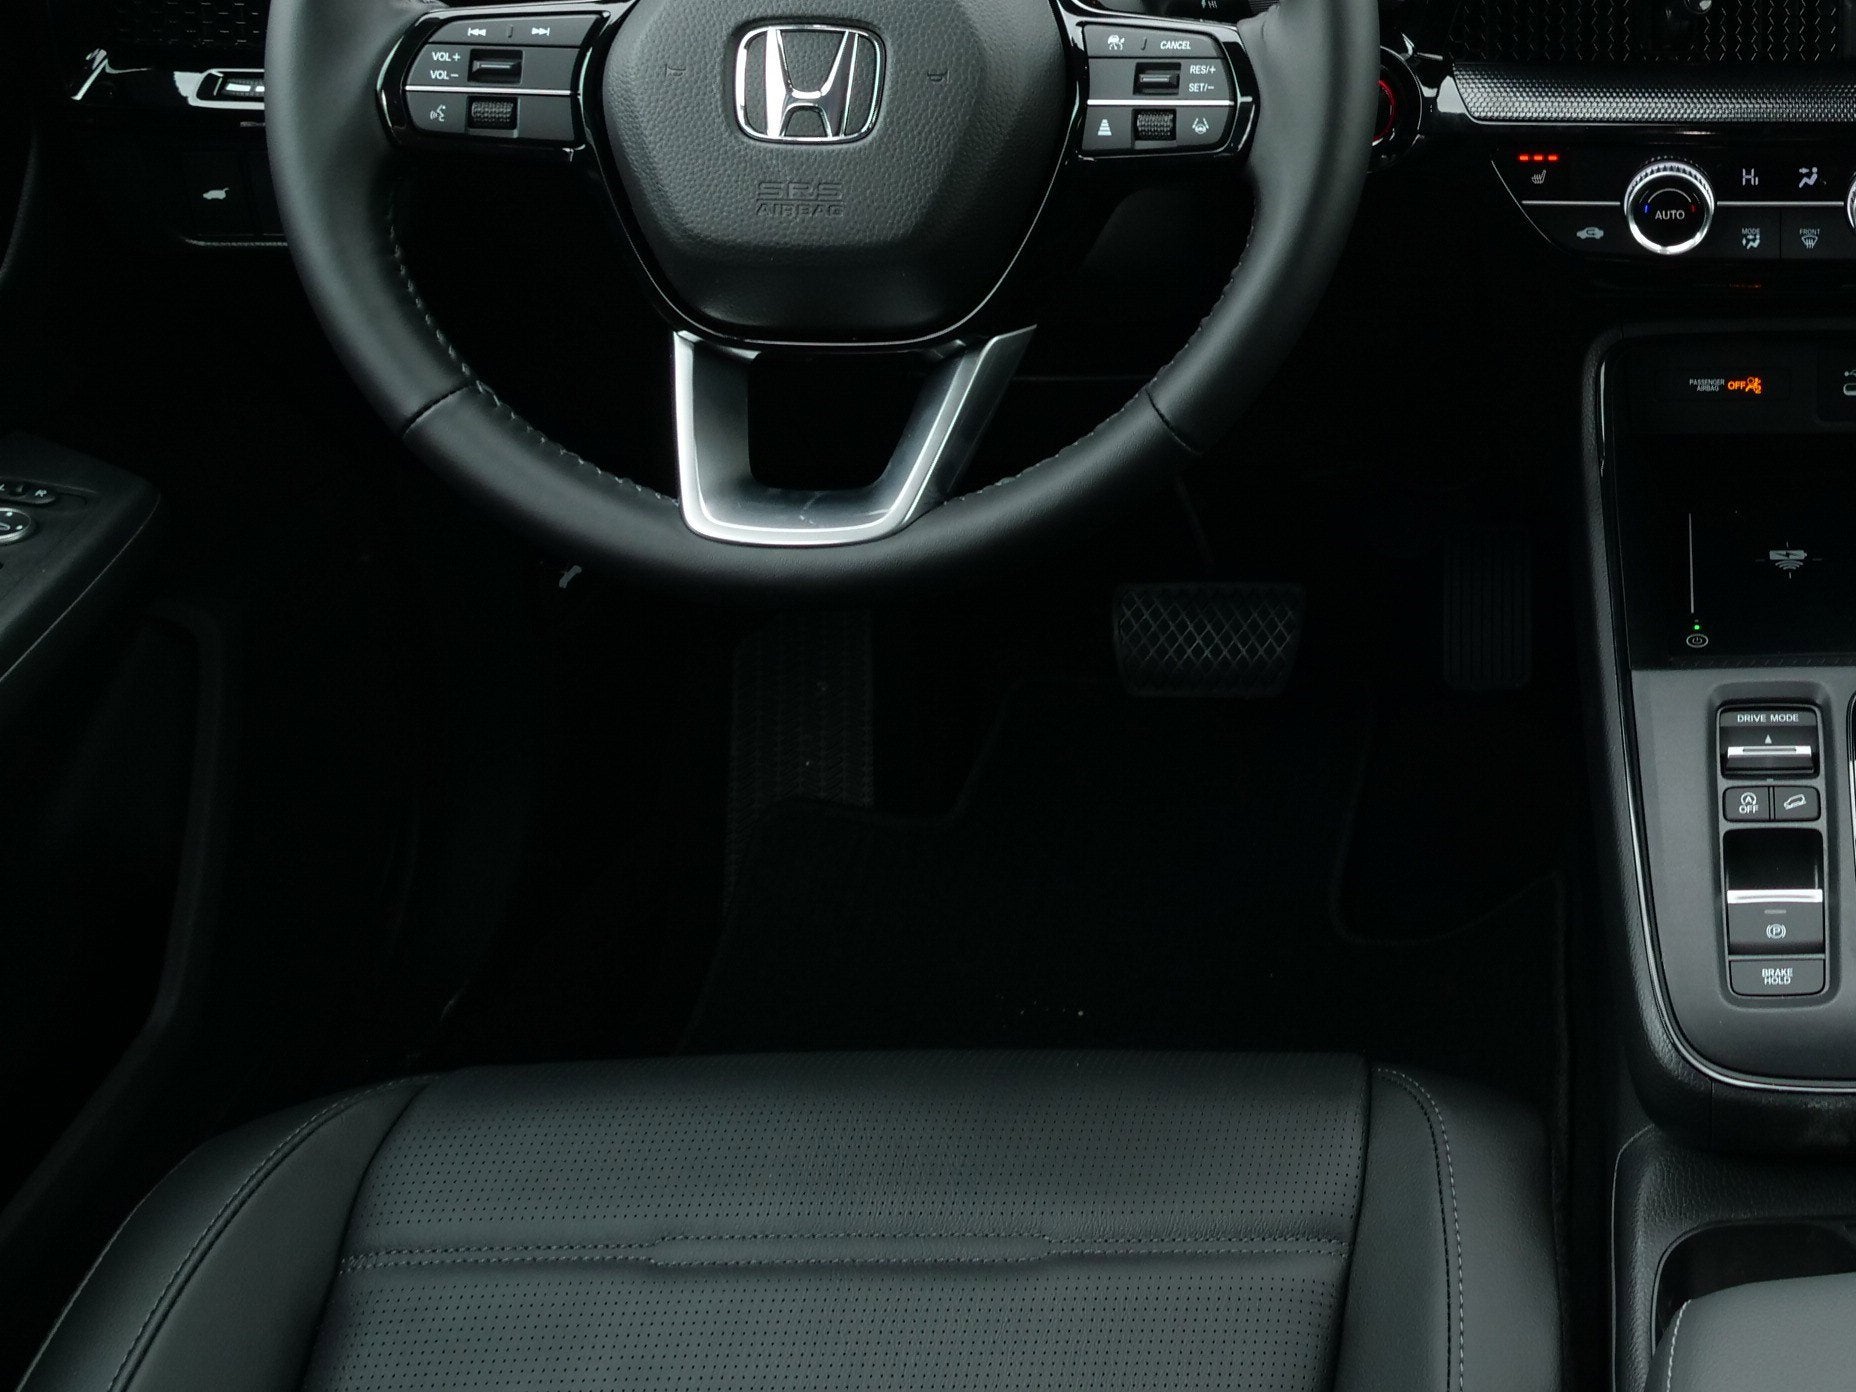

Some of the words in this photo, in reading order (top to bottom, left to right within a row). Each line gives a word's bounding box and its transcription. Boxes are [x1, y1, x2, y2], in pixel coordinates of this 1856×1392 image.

[1159, 40, 1191, 50] CANCEL
[757, 181, 844, 200] SRS
[756, 203, 844, 217] AIRBAG
[1654, 209, 1685, 220] AUTO
[1727, 380, 1747, 391] OFF
[1737, 713, 1767, 723] DRIVE
[1770, 712, 1800, 723] MODE
[1738, 805, 1759, 815] OFF
[1762, 967, 1794, 978] BRAKE
[1763, 976, 1792, 986] HOLD
